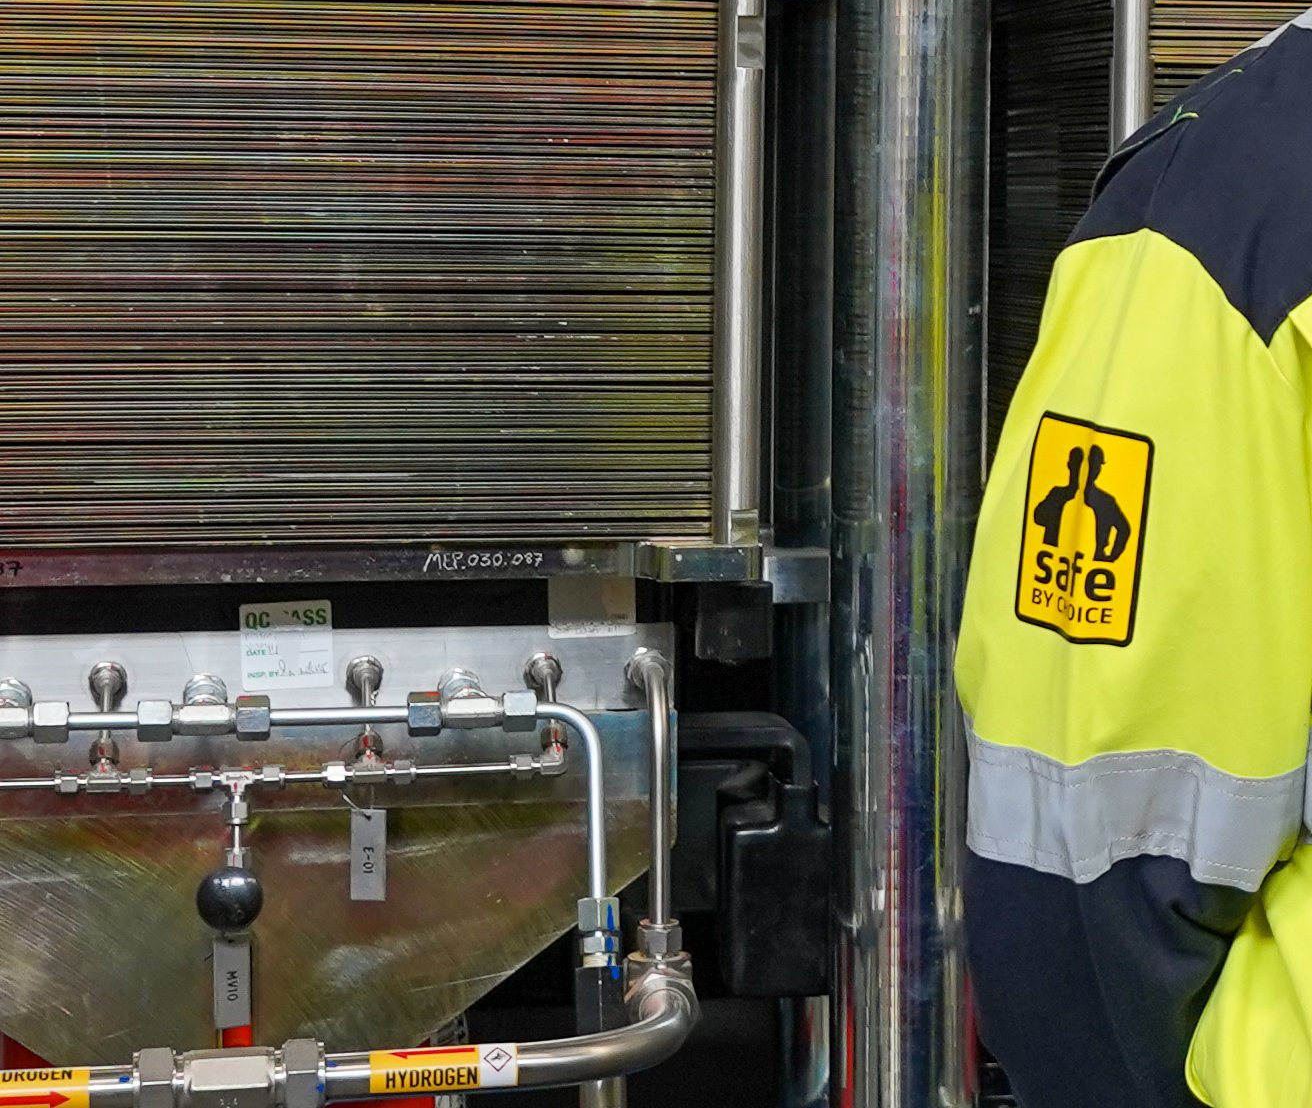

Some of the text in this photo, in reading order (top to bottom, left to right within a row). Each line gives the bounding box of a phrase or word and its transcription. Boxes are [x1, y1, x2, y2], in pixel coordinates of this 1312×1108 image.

[1033, 550, 1117, 602] safe
[245, 607, 328, 629] QC ASS
[1031, 588, 1114, 625] BY CHOICE
[362, 846, 375, 875] E-01
[226, 970, 239, 1002] MV10
[386, 1066, 478, 1090] HYDROGEN
